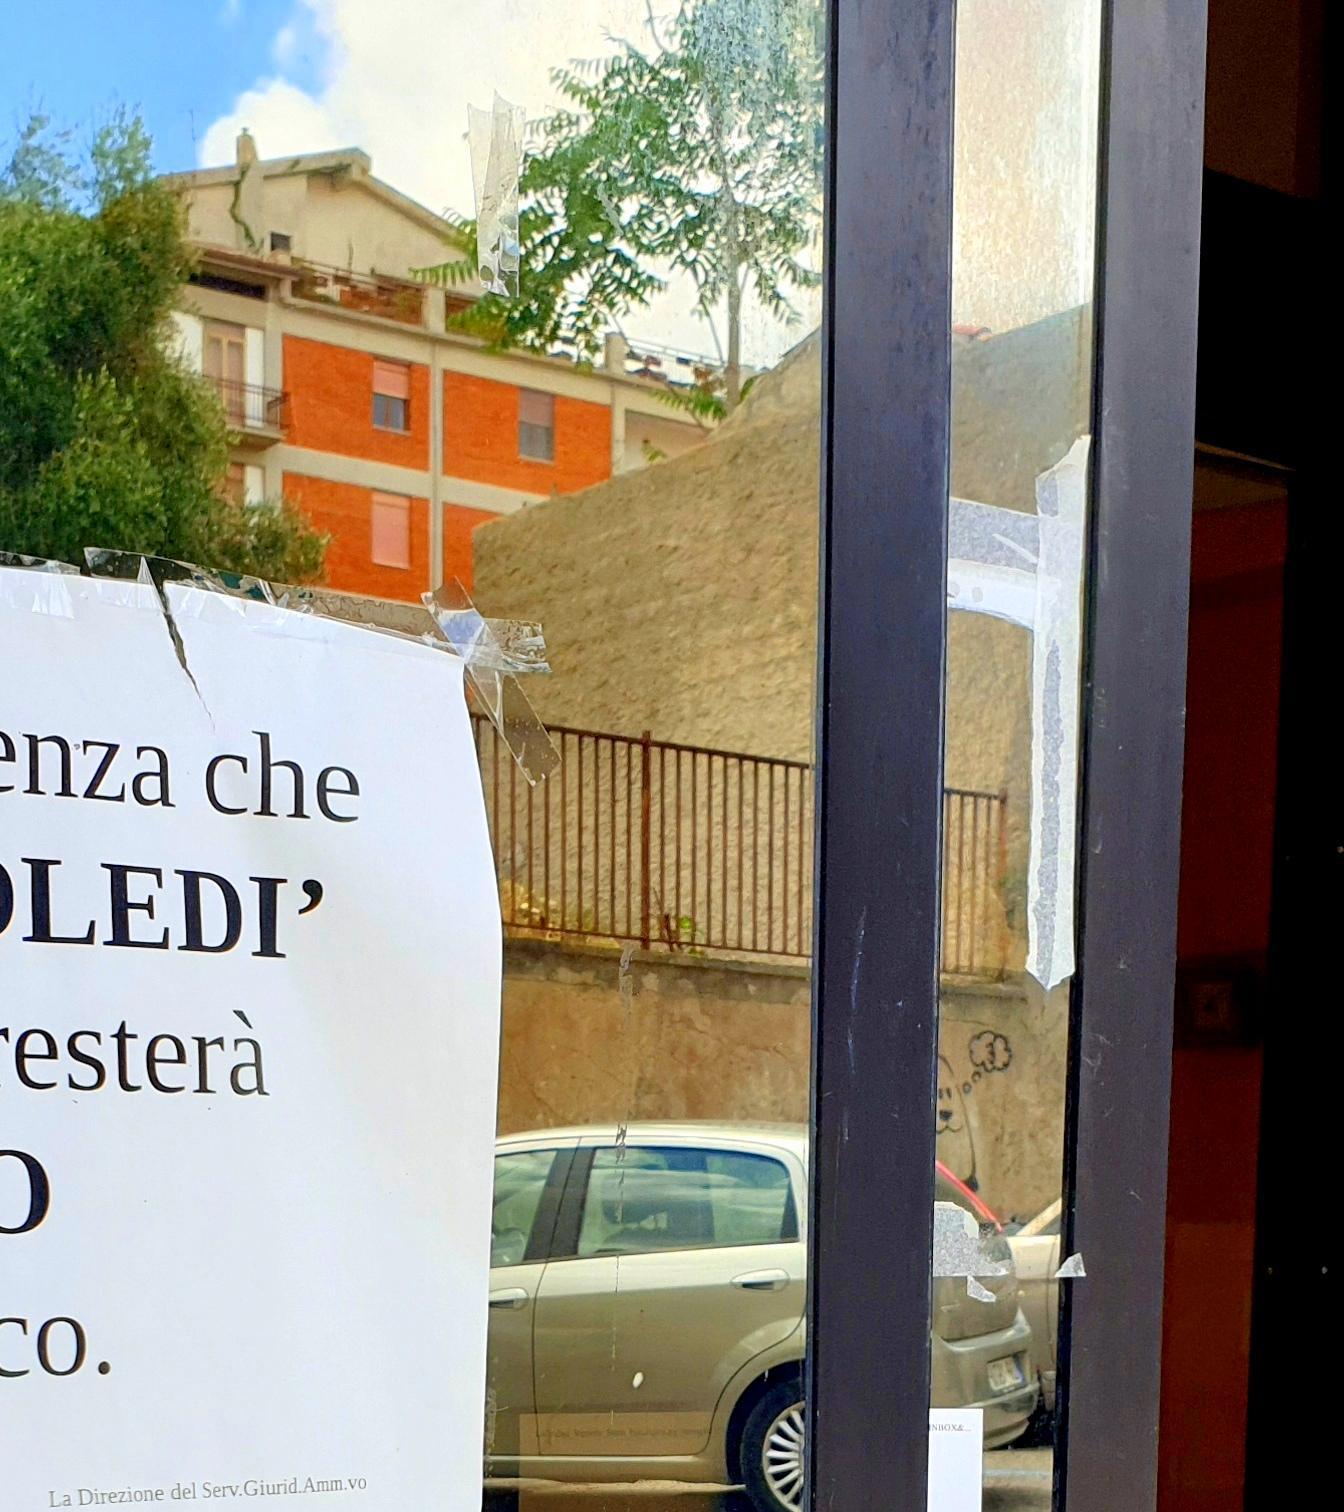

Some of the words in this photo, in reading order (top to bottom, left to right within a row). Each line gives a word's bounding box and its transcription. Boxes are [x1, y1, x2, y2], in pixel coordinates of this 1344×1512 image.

[205, 732, 361, 823] che
[49, 1490, 72, 1508] La
[78, 1487, 165, 1506] Direzione
[171, 1483, 196, 1501] del
